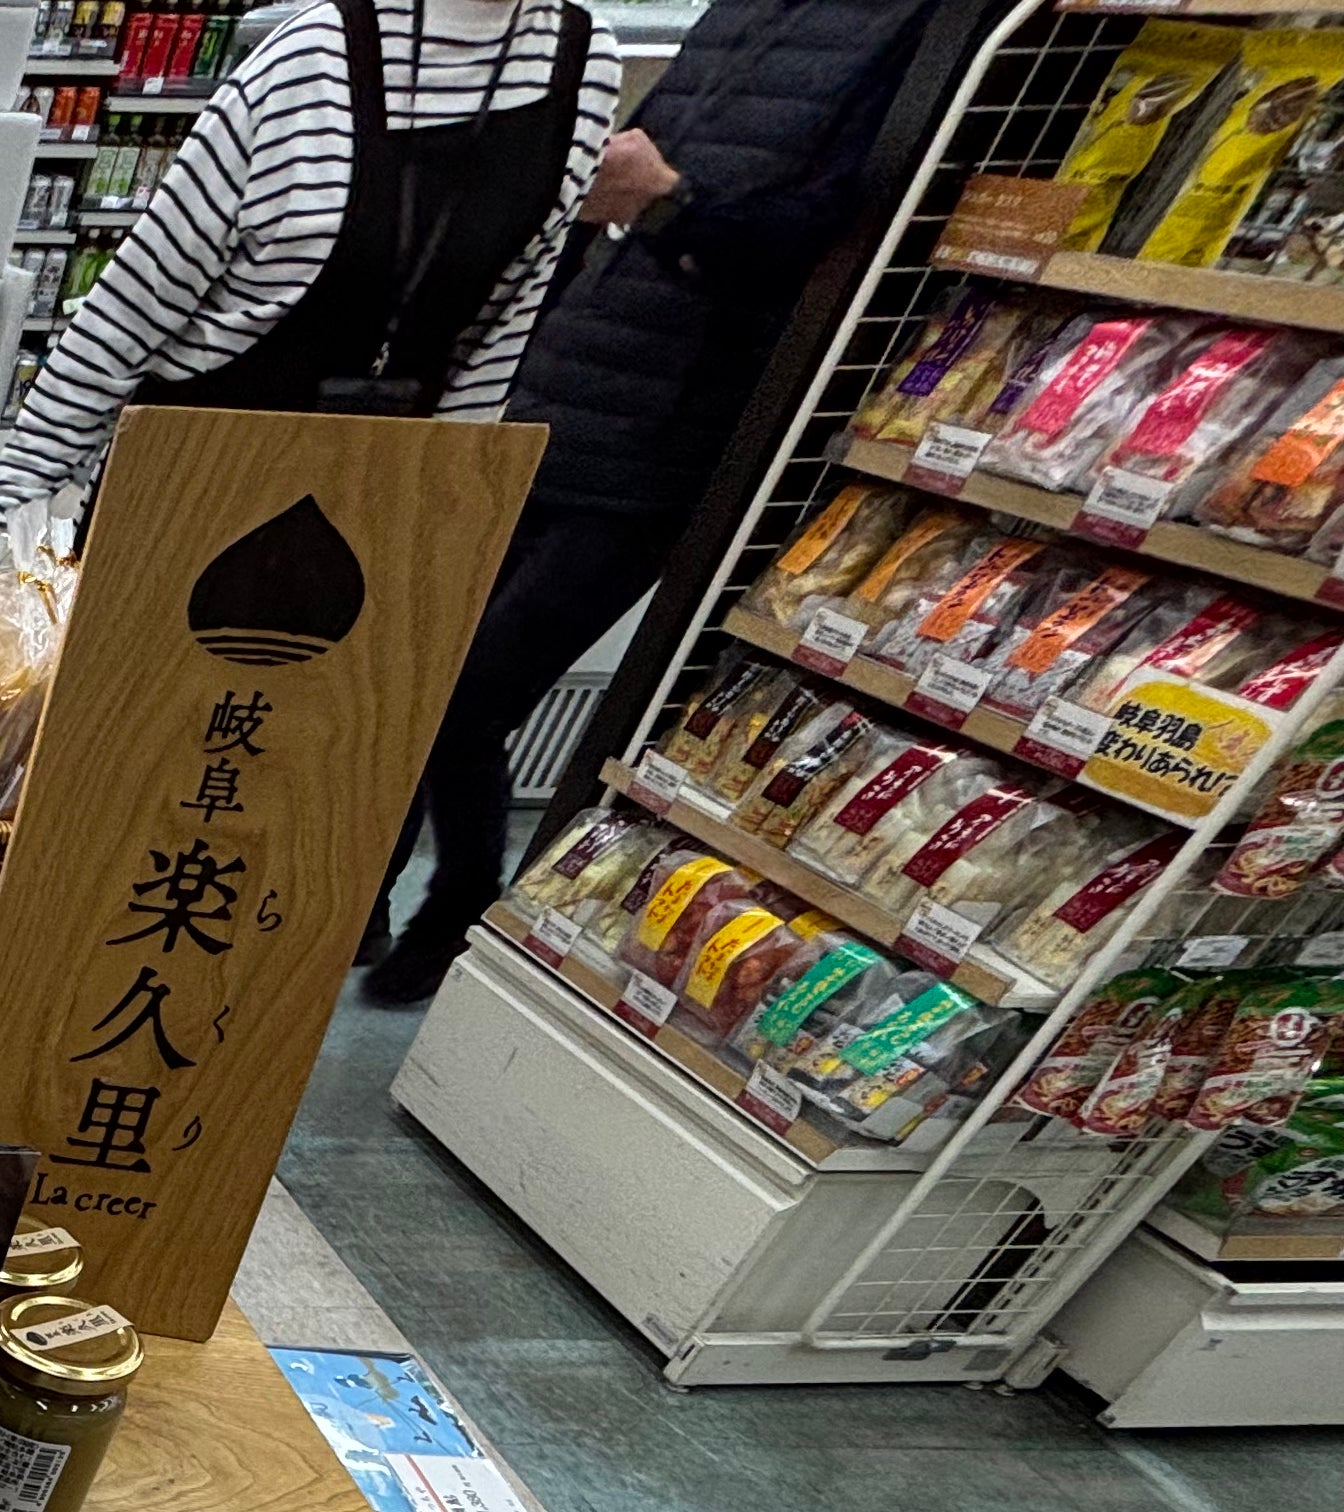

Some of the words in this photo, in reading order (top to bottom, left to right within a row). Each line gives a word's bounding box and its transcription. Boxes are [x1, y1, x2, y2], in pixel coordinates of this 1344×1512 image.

[180, 690, 273, 824] 岐阜
[1113, 700, 1203, 750] 岐阜羽島
[48, 840, 250, 1175] 楽久里
